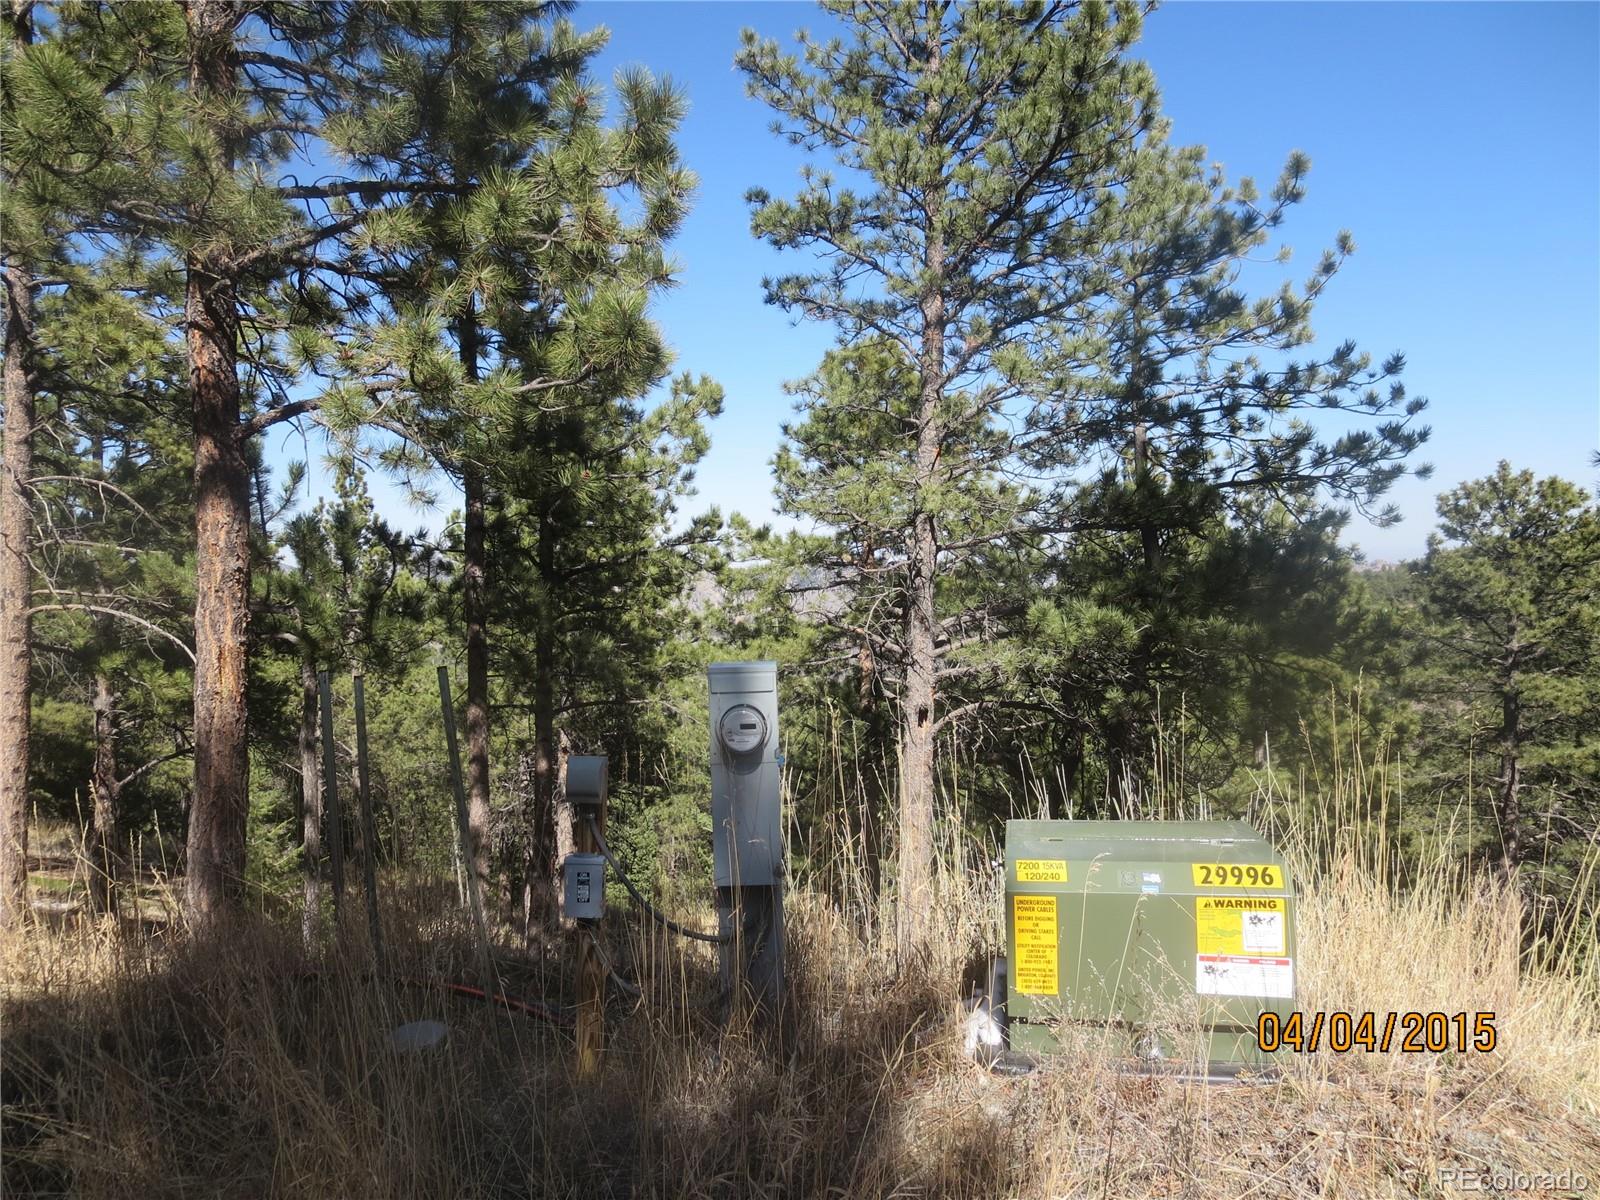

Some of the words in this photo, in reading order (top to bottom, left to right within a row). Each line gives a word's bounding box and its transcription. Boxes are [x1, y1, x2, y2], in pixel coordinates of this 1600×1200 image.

[1017, 861, 1040, 870] 7200
[1042, 862, 1065, 870] 15KVA
[1024, 872, 1061, 881] 120/240
[1199, 865, 1274, 886] 29996
[1214, 899, 1277, 909] WARNING
